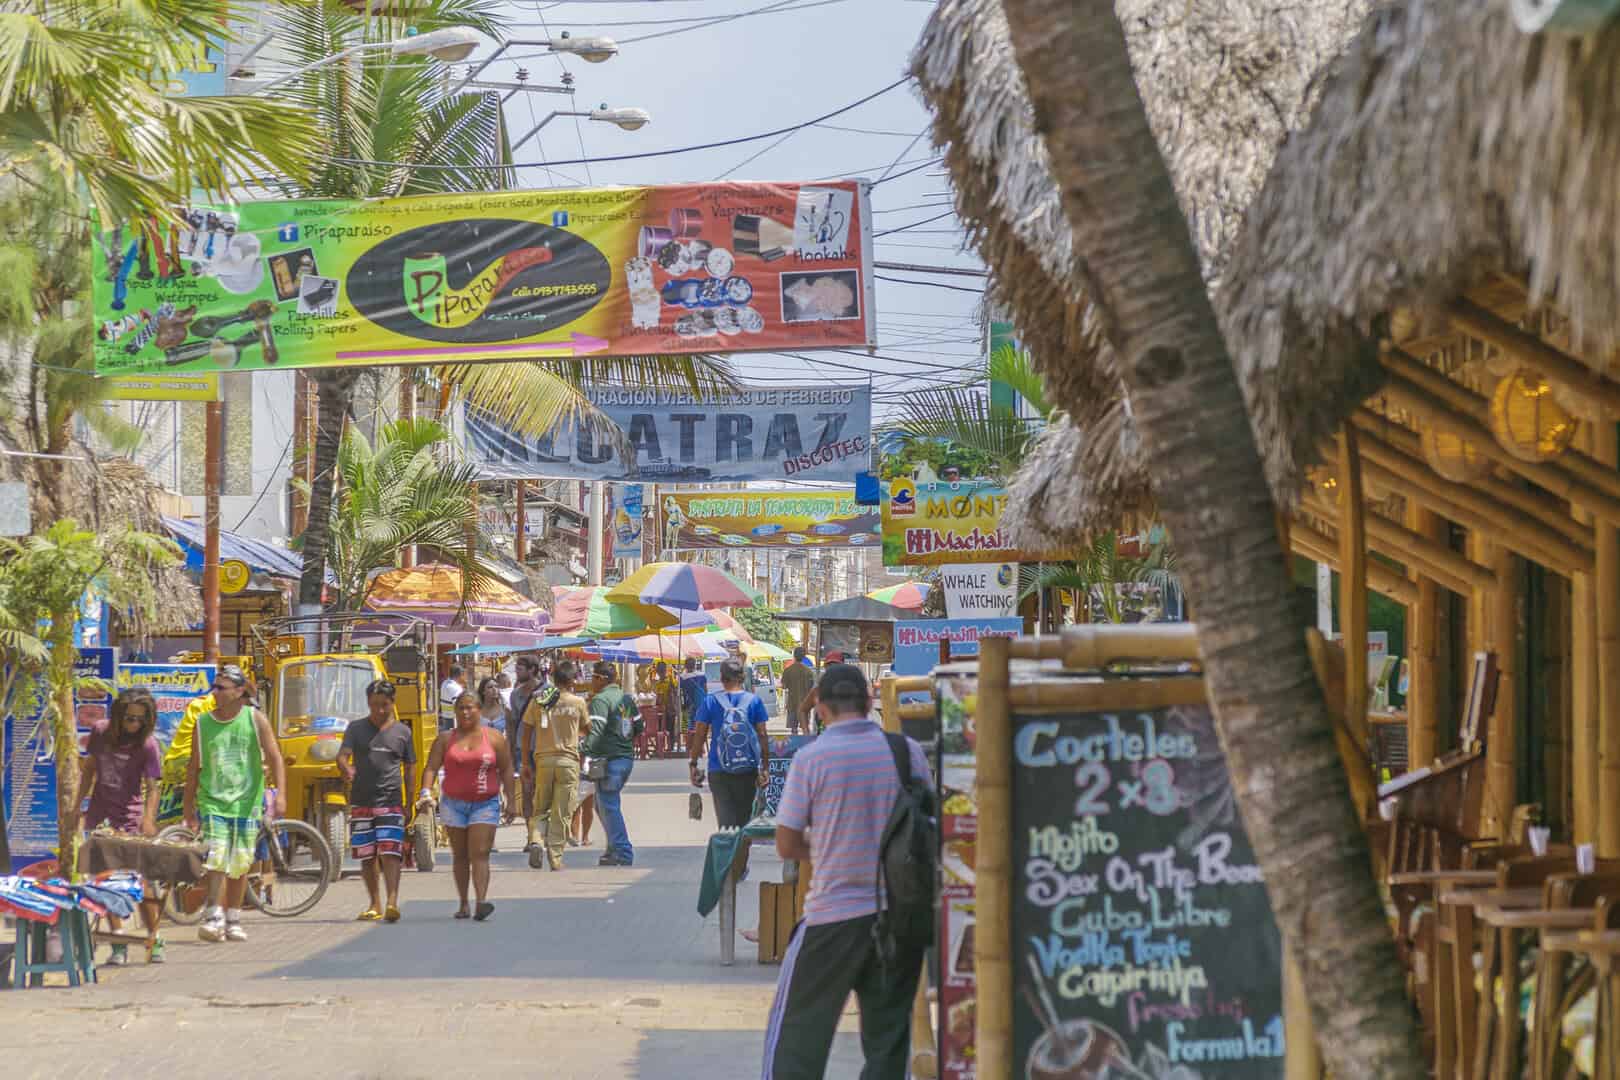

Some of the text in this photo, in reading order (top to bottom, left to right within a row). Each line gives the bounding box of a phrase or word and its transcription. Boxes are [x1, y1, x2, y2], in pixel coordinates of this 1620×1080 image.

[756, 389, 774, 405] DE
[783, 388, 853, 405] FEBRERO
[927, 494, 1008, 519] MONT
[944, 574, 986, 589] WHALE
[959, 595, 1013, 609] WATCHING
[1014, 713, 1198, 768] Cocteles
[1074, 761, 1112, 816] 2
[1028, 816, 1119, 871] Mojito
[1026, 859, 1099, 906] Sex
[1106, 856, 1149, 903] On
[1147, 885, 1232, 930] Libre
